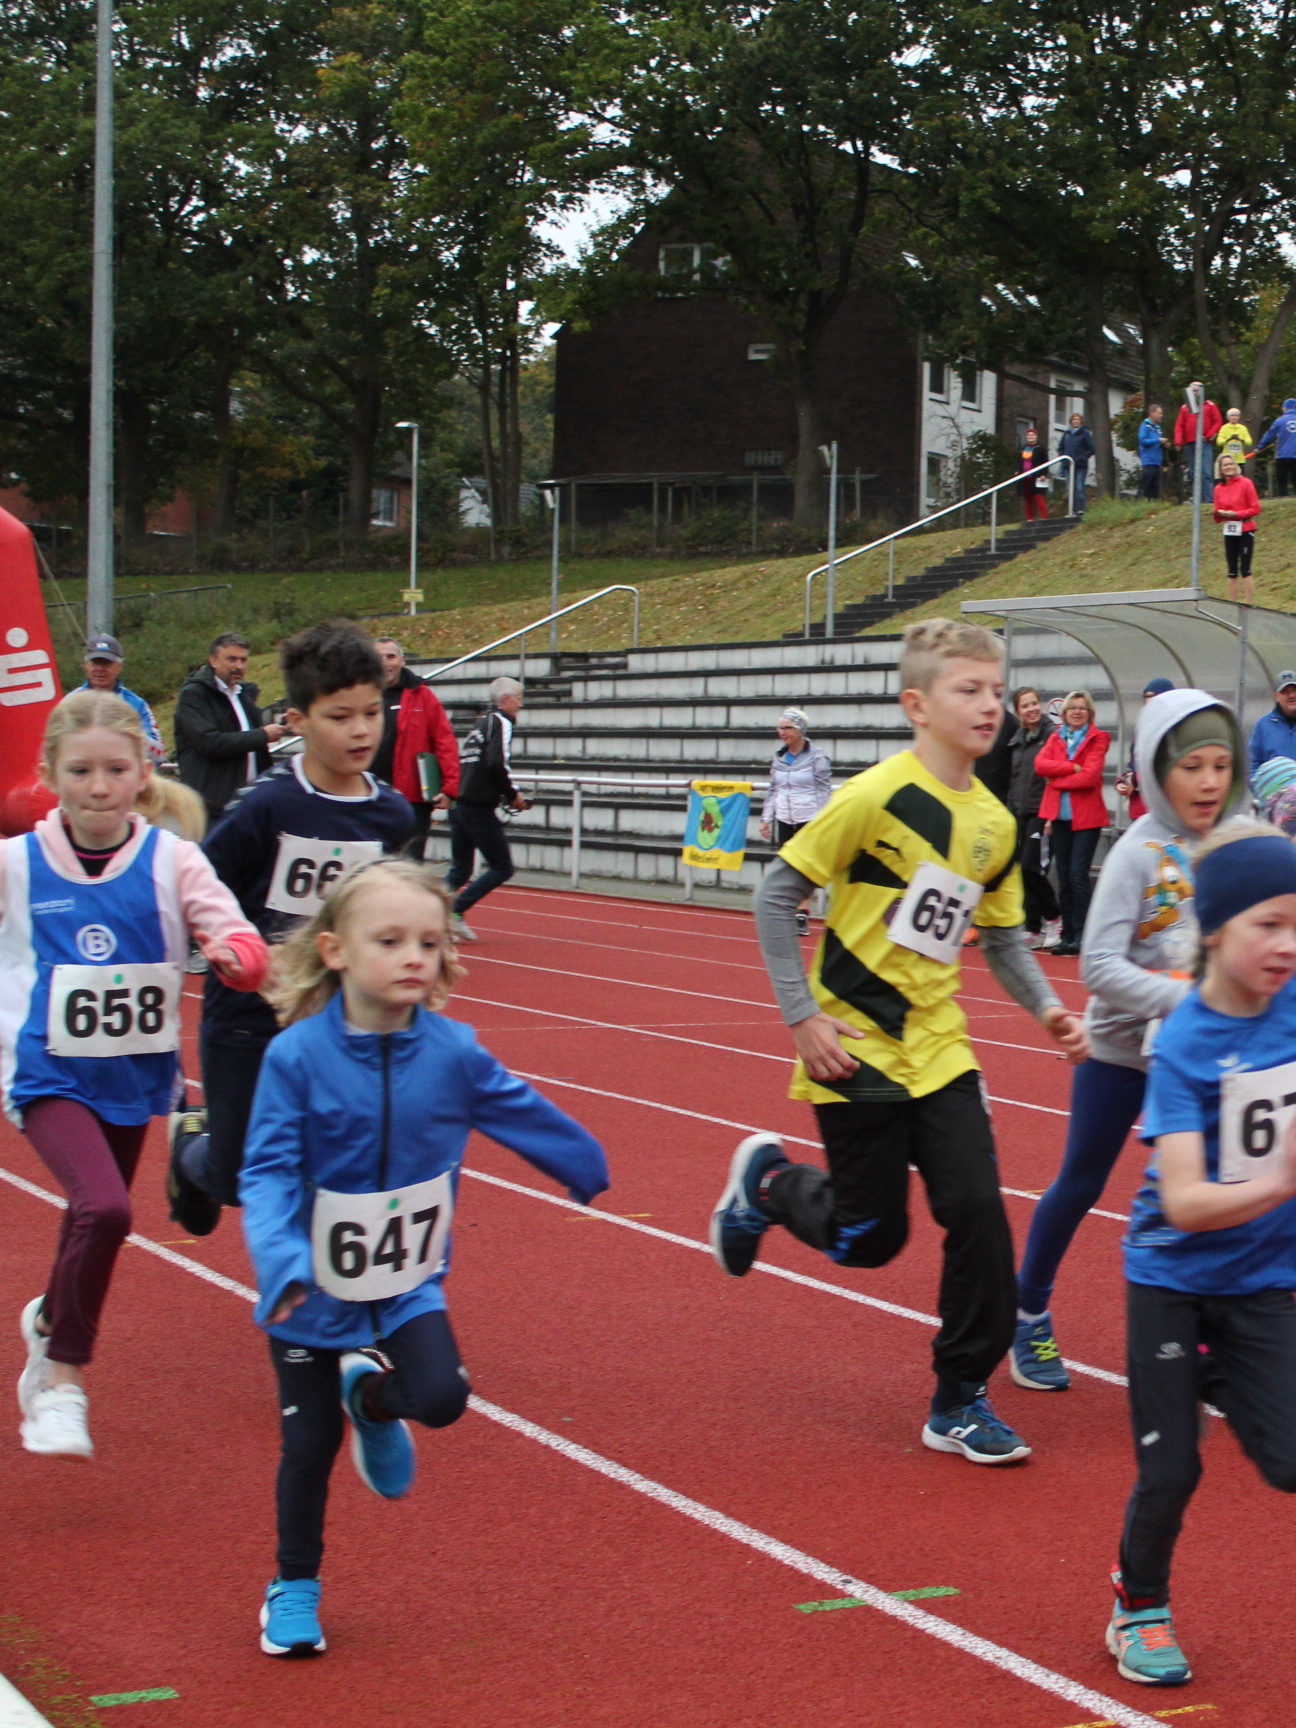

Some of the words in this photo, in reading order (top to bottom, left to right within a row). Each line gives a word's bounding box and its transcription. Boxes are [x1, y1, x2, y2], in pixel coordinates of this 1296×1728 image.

[286, 857, 345, 901] 66
[66, 986, 165, 1038] 658
[330, 1204, 440, 1279] 647
